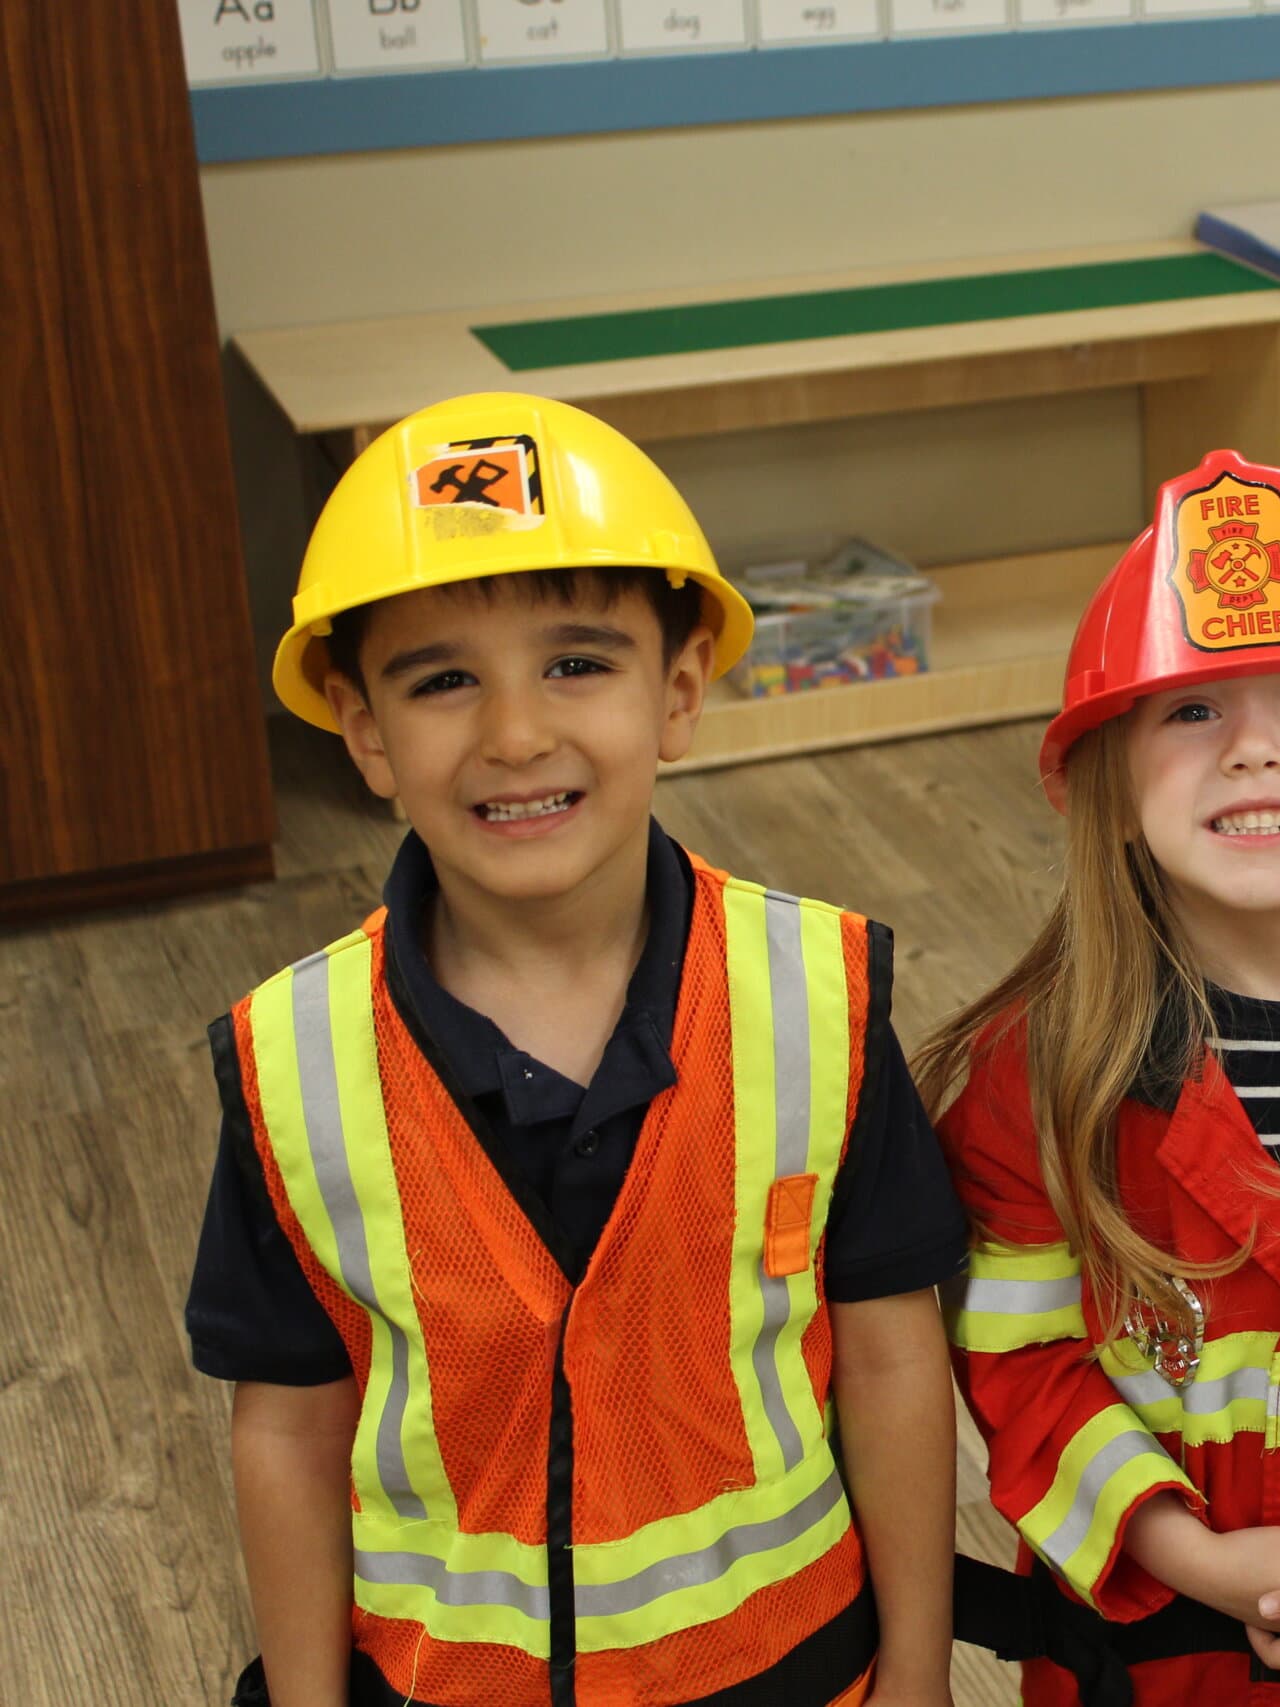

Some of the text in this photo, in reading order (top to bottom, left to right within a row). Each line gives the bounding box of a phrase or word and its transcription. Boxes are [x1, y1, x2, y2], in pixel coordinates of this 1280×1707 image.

[525, 18, 559, 41] cat
[663, 8, 701, 39] dog
[801, 6, 836, 29] egg
[380, 26, 417, 50] ball
[221, 37, 277, 69] apple
[1199, 494, 1261, 520] FIRE
